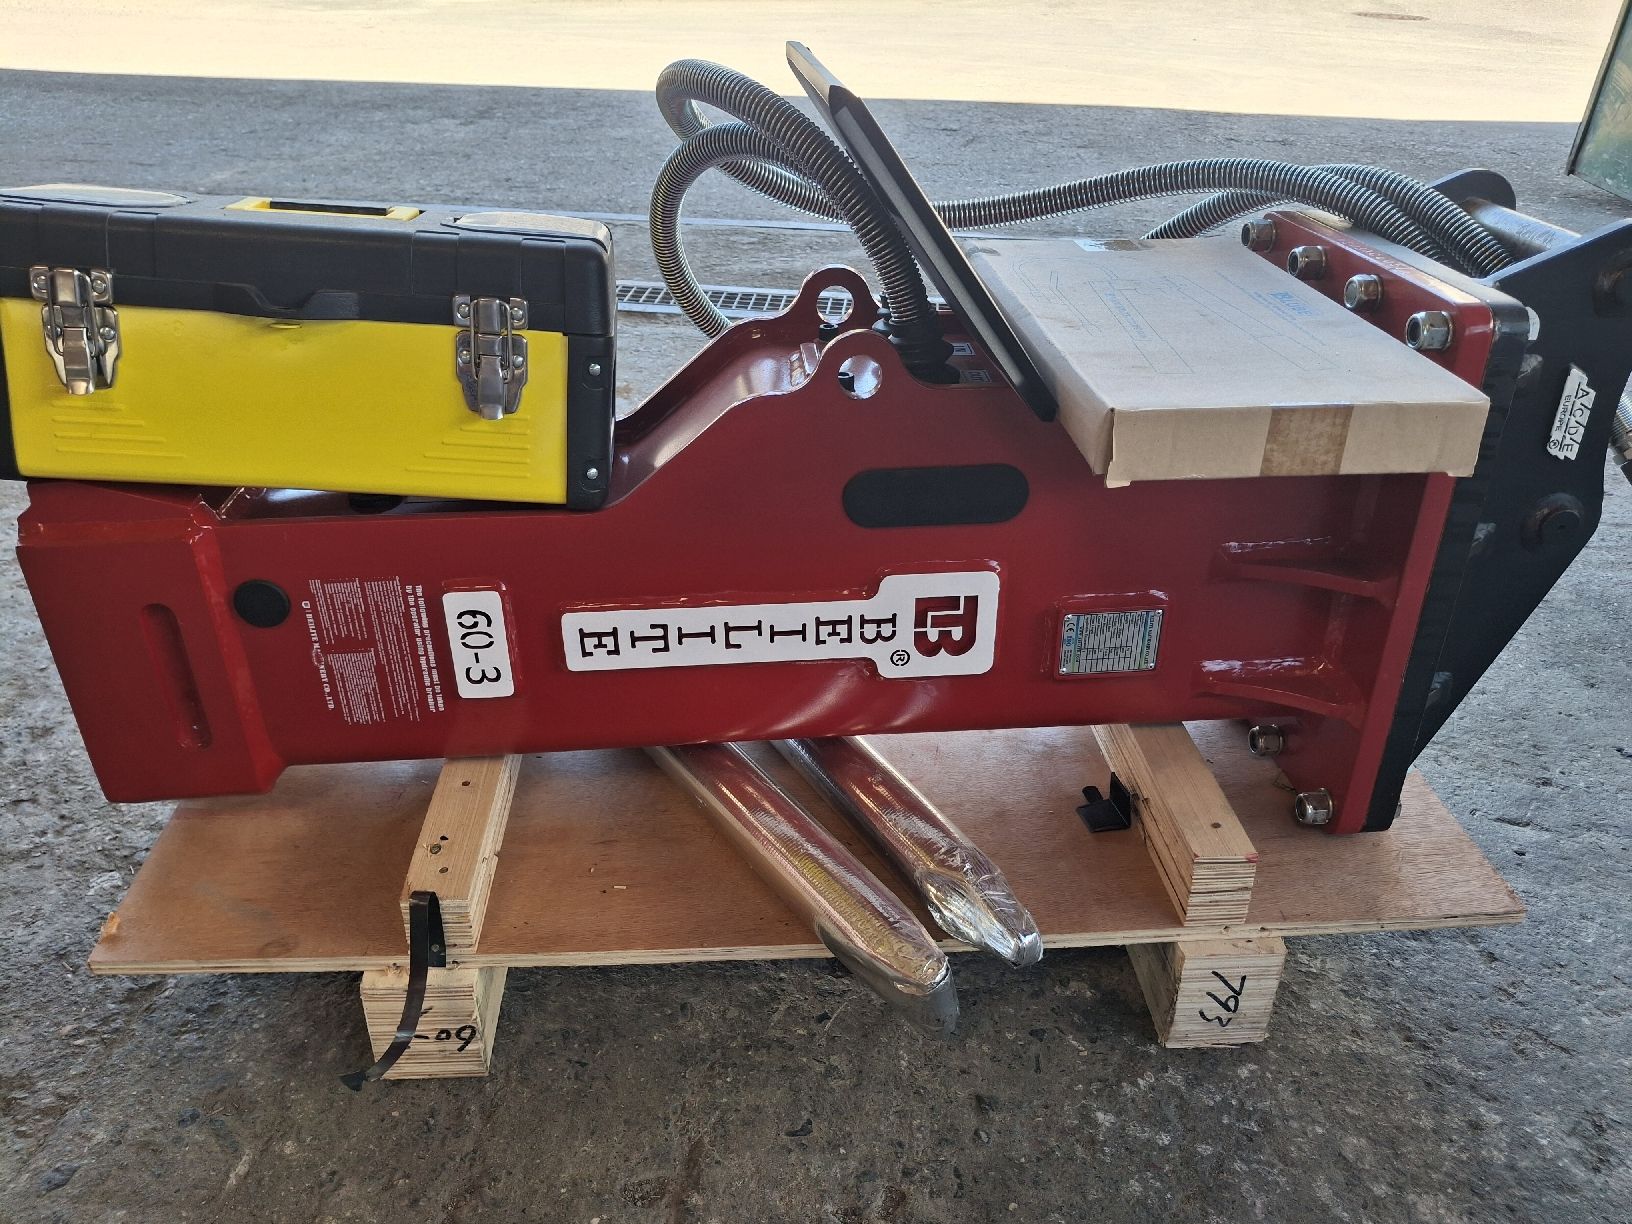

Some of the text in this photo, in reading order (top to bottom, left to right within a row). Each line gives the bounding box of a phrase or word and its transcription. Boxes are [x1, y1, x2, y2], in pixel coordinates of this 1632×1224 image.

[1554, 394, 1571, 432] EUROPE
[410, 608, 420, 636] operator
[417, 598, 429, 628] following
[423, 630, 436, 667] precautions
[431, 669, 439, 684] must
[579, 613, 898, 659] BEILITE
[415, 638, 425, 655] using
[456, 609, 501, 685] 60-3
[418, 656, 431, 686] hydraulic
[1198, 970, 1247, 1028] 793
